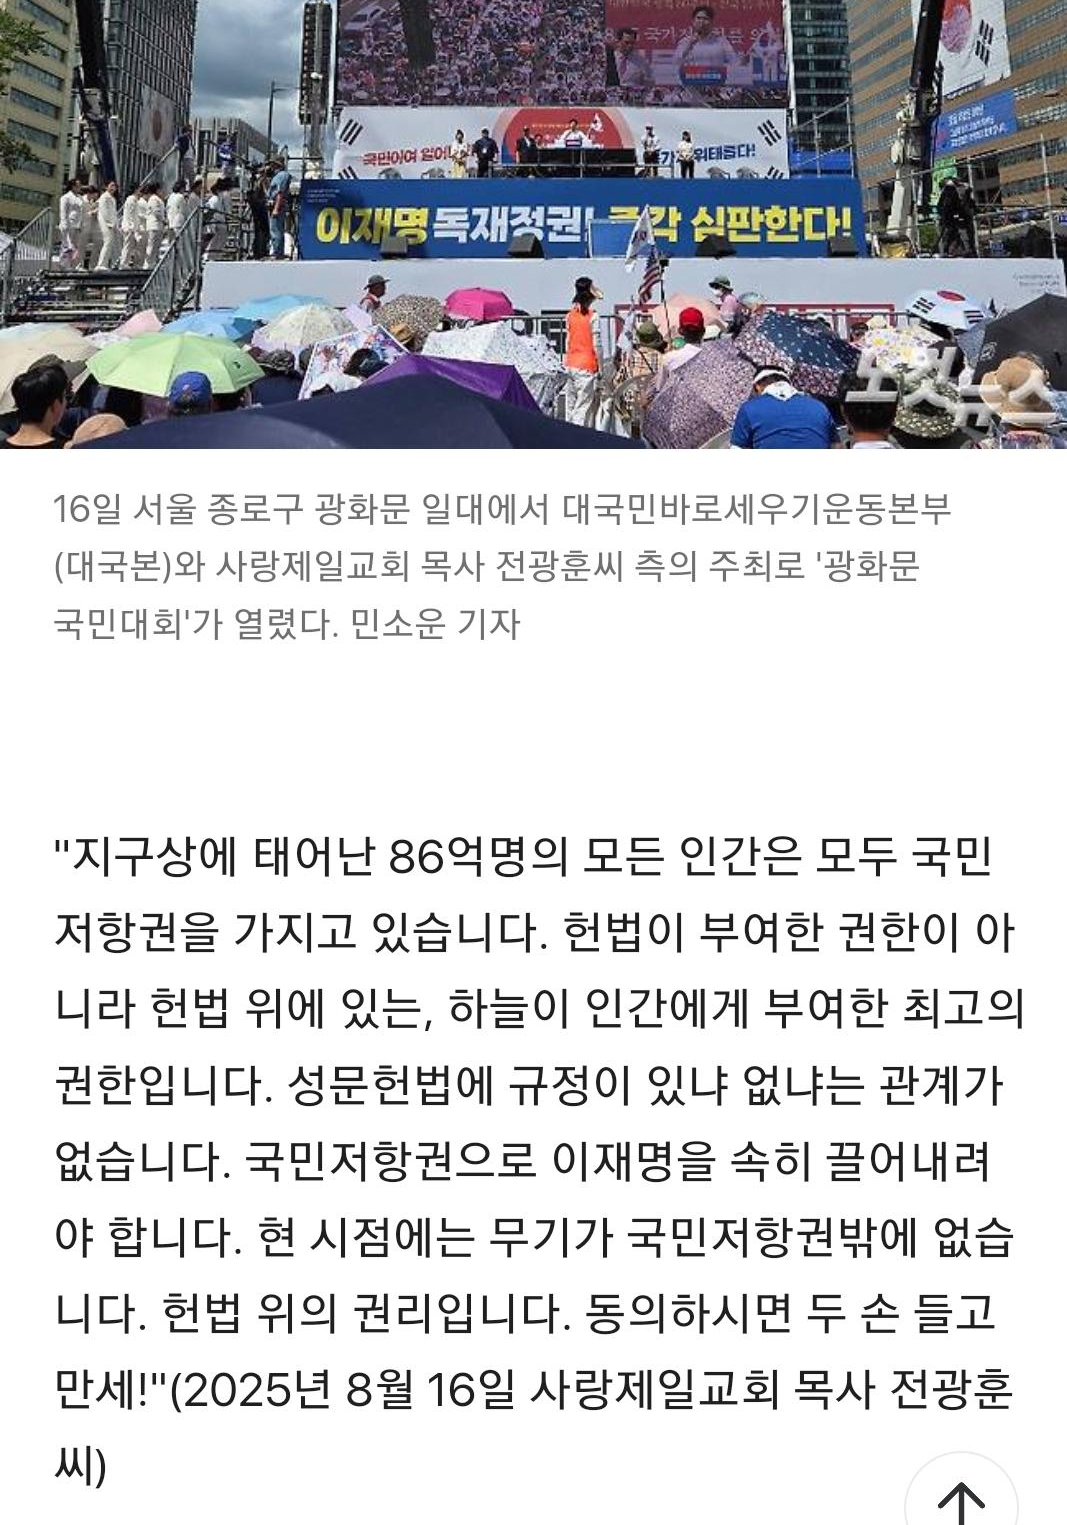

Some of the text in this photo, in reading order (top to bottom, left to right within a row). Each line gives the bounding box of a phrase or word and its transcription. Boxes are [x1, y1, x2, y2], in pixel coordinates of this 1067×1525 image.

[363, 149, 417, 167] 국민이여
[316, 207, 430, 245] 이재명
[690, 205, 852, 243] 심판한다!
[54, 493, 951, 525] 16일 서울 종로구 광화문 일대에서 대국민바로세우기운동본부
[56, 550, 919, 584] (대국본)와 사랑제일교회 목사 전광훈씨 측의 주최로 '광화문
[54, 608, 520, 640] 국민대회'가 열렸다. 민소운 기자
[55, 836, 990, 877] "지구상에 태어난 86억명의 모든 인간은 모두 국민
[55, 912, 1015, 953] 저항권을 가지고 있습니다. 헌법이 부여한 권한이 아
[58, 988, 1022, 1031] 니라 헌법 위에 있는, 하늘이 인간에게 부여한 최고의
[56, 1065, 1003, 1106] 권한입니다. 성문헌법에 규정이 있냐 없냐는 관계가
[56, 1141, 987, 1182] 없습니다. 국민저항권으로 이재명을 속히 끌어내려
[56, 1217, 1013, 1258] 야 합니다. 현 시점에는 무기가 국민저항권밖에 없습
[58, 1293, 995, 1334] 니다. 헌법 위의 권리입니다. 동의하시면 두 손 들고
[57, 1369, 1012, 1413] 만세!"(2025년 8월 16일 사랑제일교회 목사 전광훈
[55, 1446, 105, 1489] 씨)
